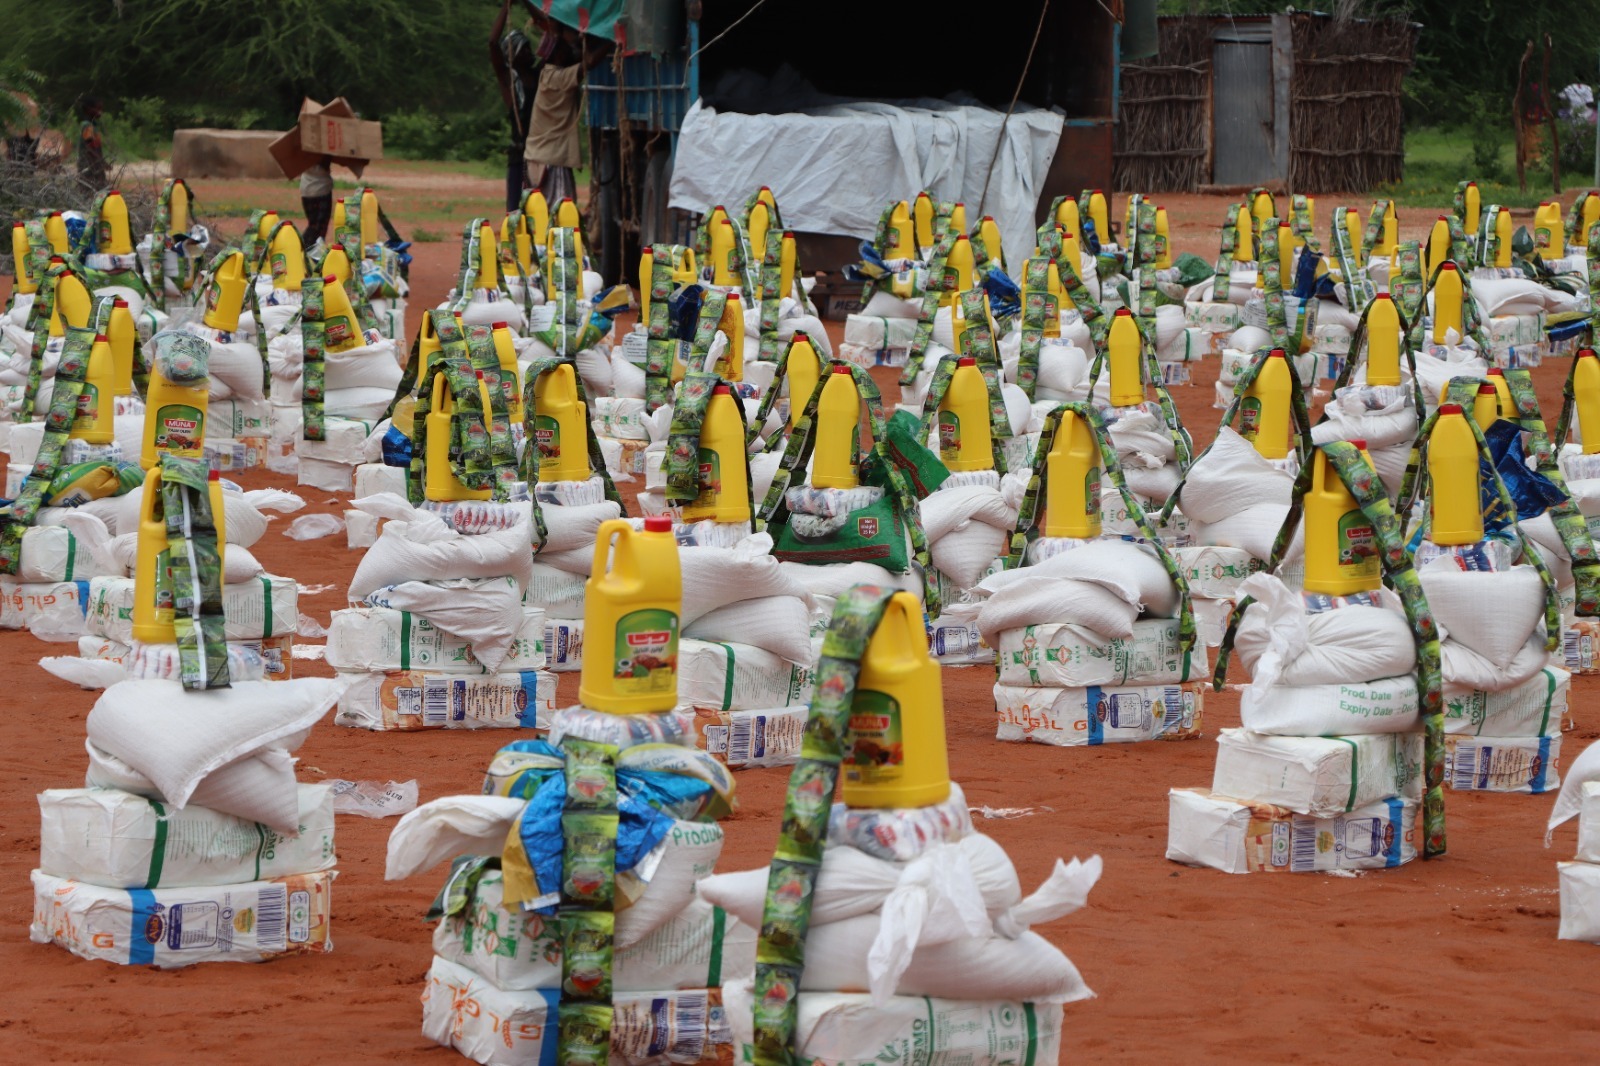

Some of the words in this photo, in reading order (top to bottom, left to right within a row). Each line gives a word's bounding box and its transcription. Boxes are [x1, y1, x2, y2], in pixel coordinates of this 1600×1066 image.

[169, 420, 191, 428] MUNA
[1370, 691, 1392, 700] Date
[1340, 700, 1371, 717] Expiry
[1373, 706, 1393, 716] Date
[150, 917, 159, 939] Ajab
[911, 1018, 923, 1066] OSMO
